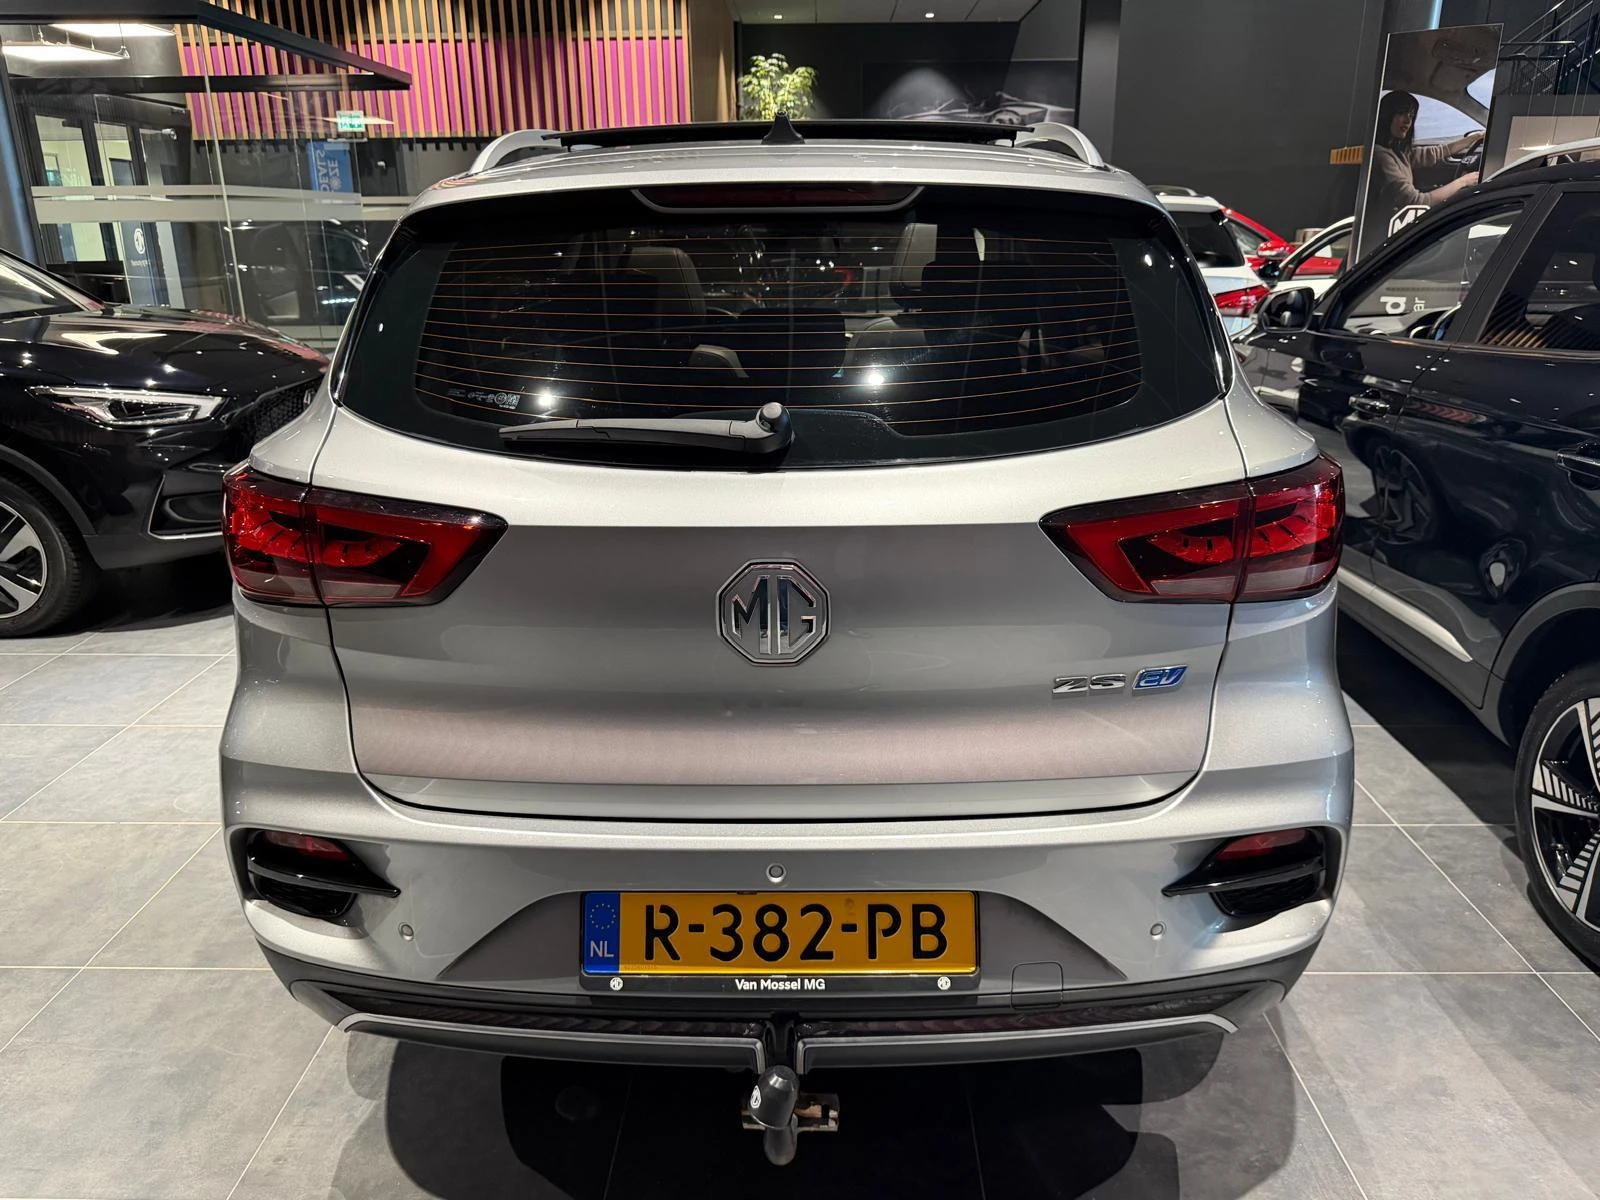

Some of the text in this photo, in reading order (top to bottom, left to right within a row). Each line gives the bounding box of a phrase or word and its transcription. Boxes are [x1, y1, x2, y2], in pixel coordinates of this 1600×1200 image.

[729, 573, 817, 656] MG
[1052, 666, 1184, 694] ZS EV
[644, 903, 948, 962] R-382-PB
[590, 940, 614, 957] NL
[735, 978, 826, 990] Van Mossel MG
